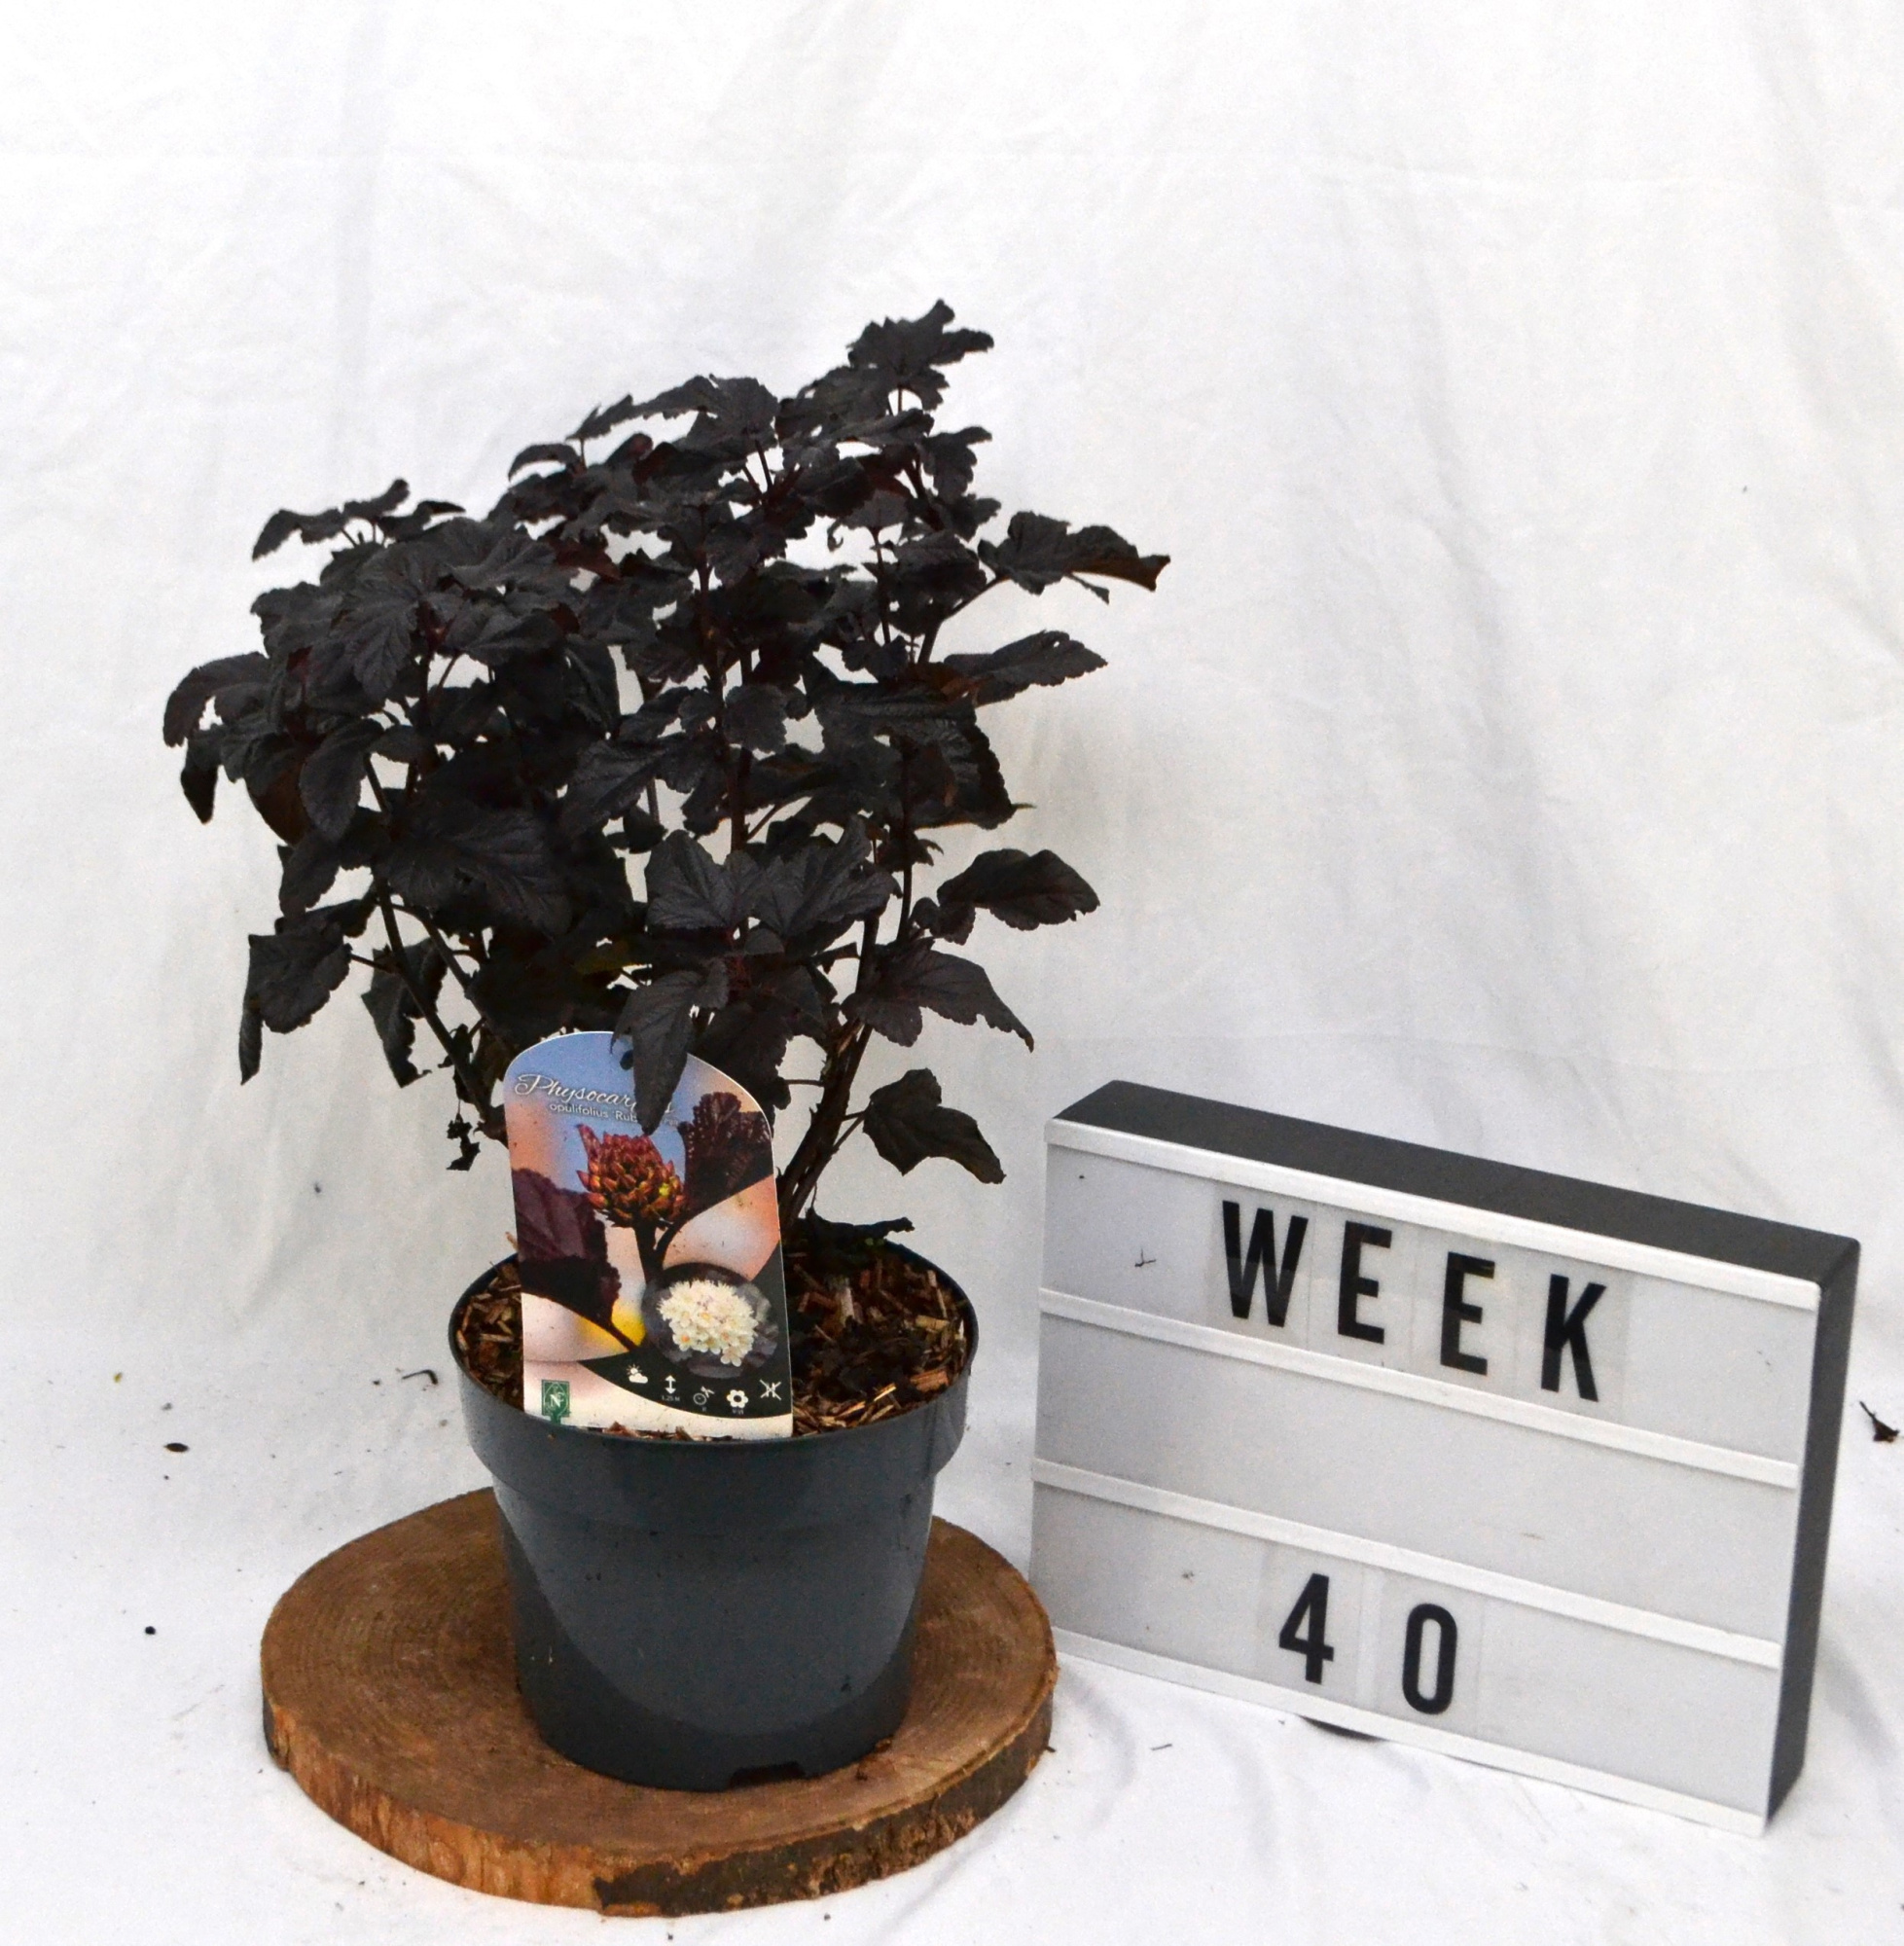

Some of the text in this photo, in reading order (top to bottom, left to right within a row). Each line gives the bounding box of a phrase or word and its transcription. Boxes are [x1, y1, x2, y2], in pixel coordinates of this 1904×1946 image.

[550, 1102, 609, 1118] opulifolius
[1222, 1200, 1607, 1402] WEEK
[1278, 1572, 1457, 1715] 40
